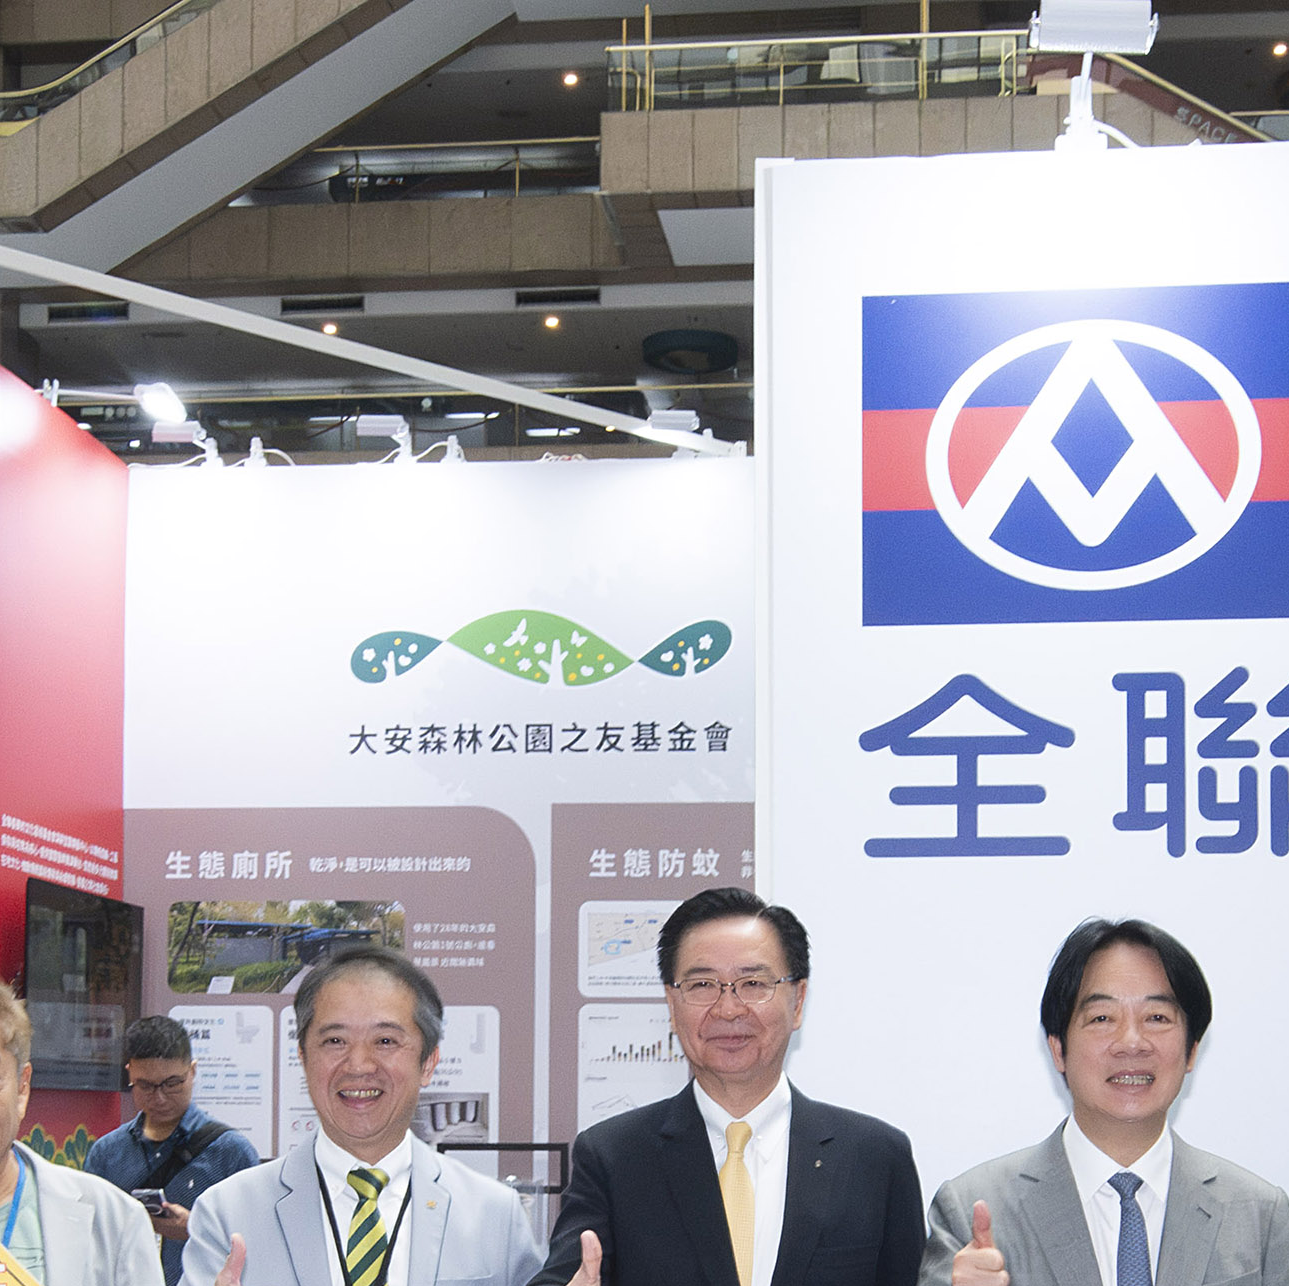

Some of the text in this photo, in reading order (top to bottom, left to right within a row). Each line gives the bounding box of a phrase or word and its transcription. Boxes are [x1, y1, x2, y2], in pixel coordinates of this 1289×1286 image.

[348, 722, 734, 756] 大安森林公園之友基金會
[165, 850, 293, 880] 生態廁所
[588, 848, 720, 878] 生態防蚊
